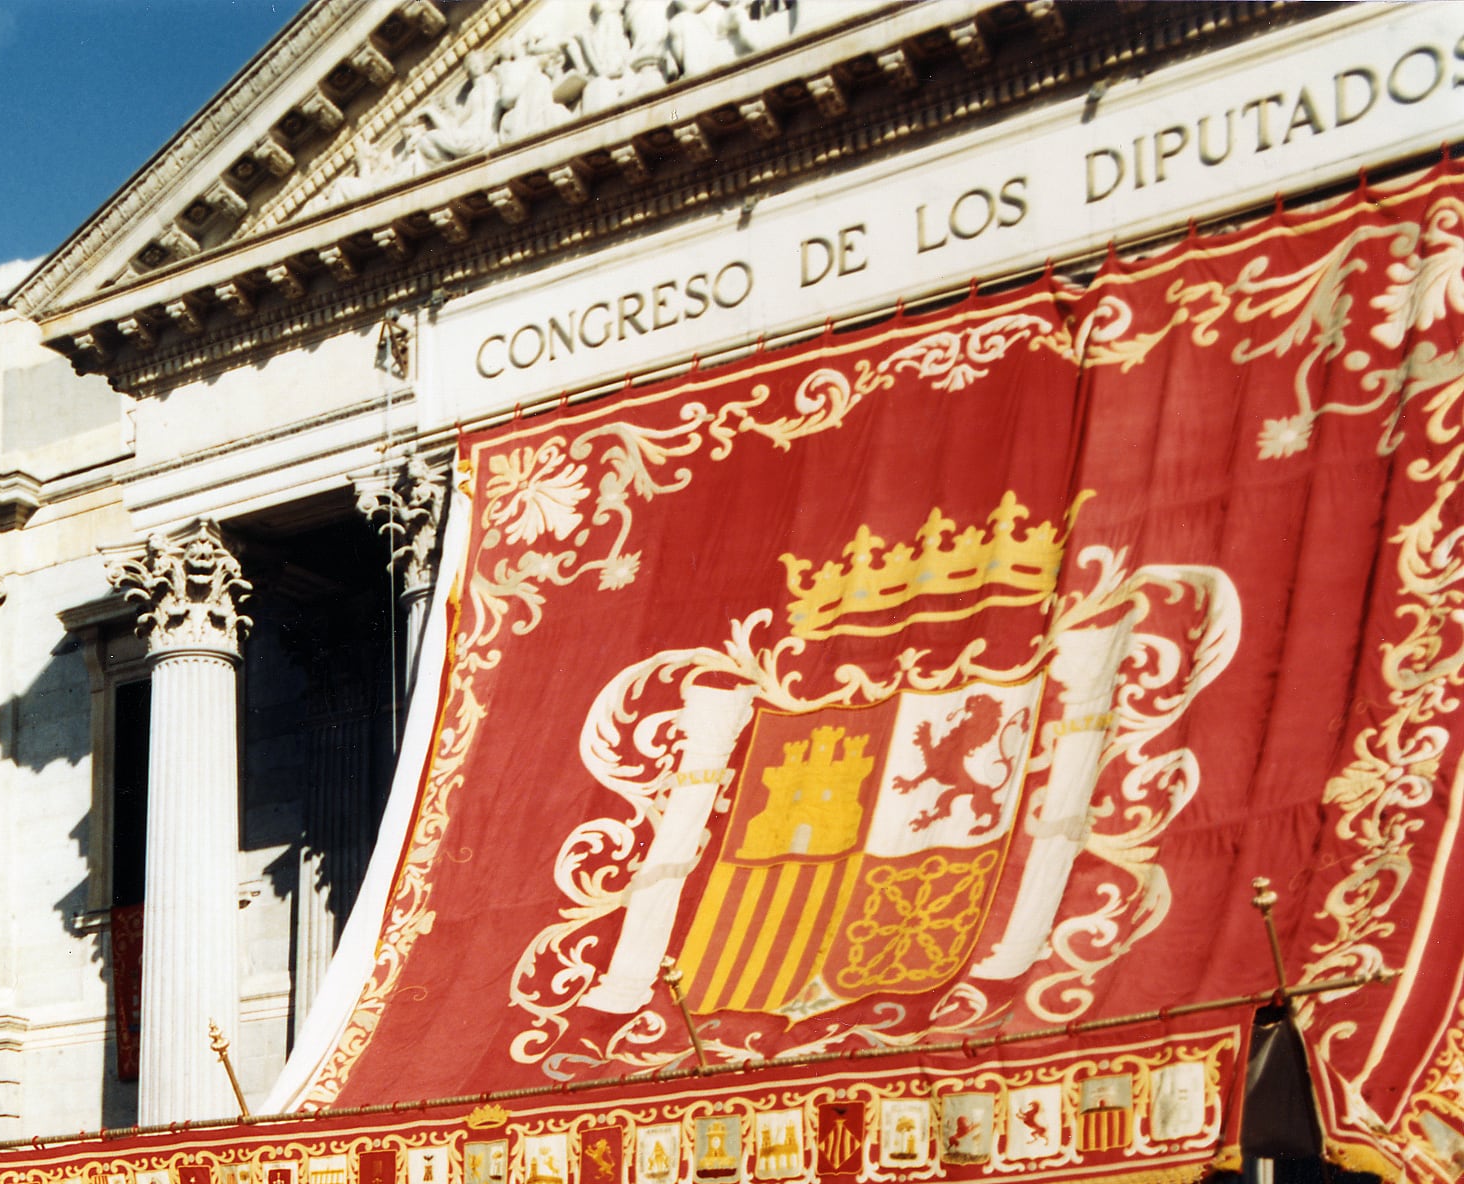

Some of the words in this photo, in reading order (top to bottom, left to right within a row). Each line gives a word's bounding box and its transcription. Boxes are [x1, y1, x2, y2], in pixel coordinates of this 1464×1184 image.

[475, 260, 754, 379] CONGRESO
[800, 223, 868, 288] DE
[915, 176, 1029, 255] LOS
